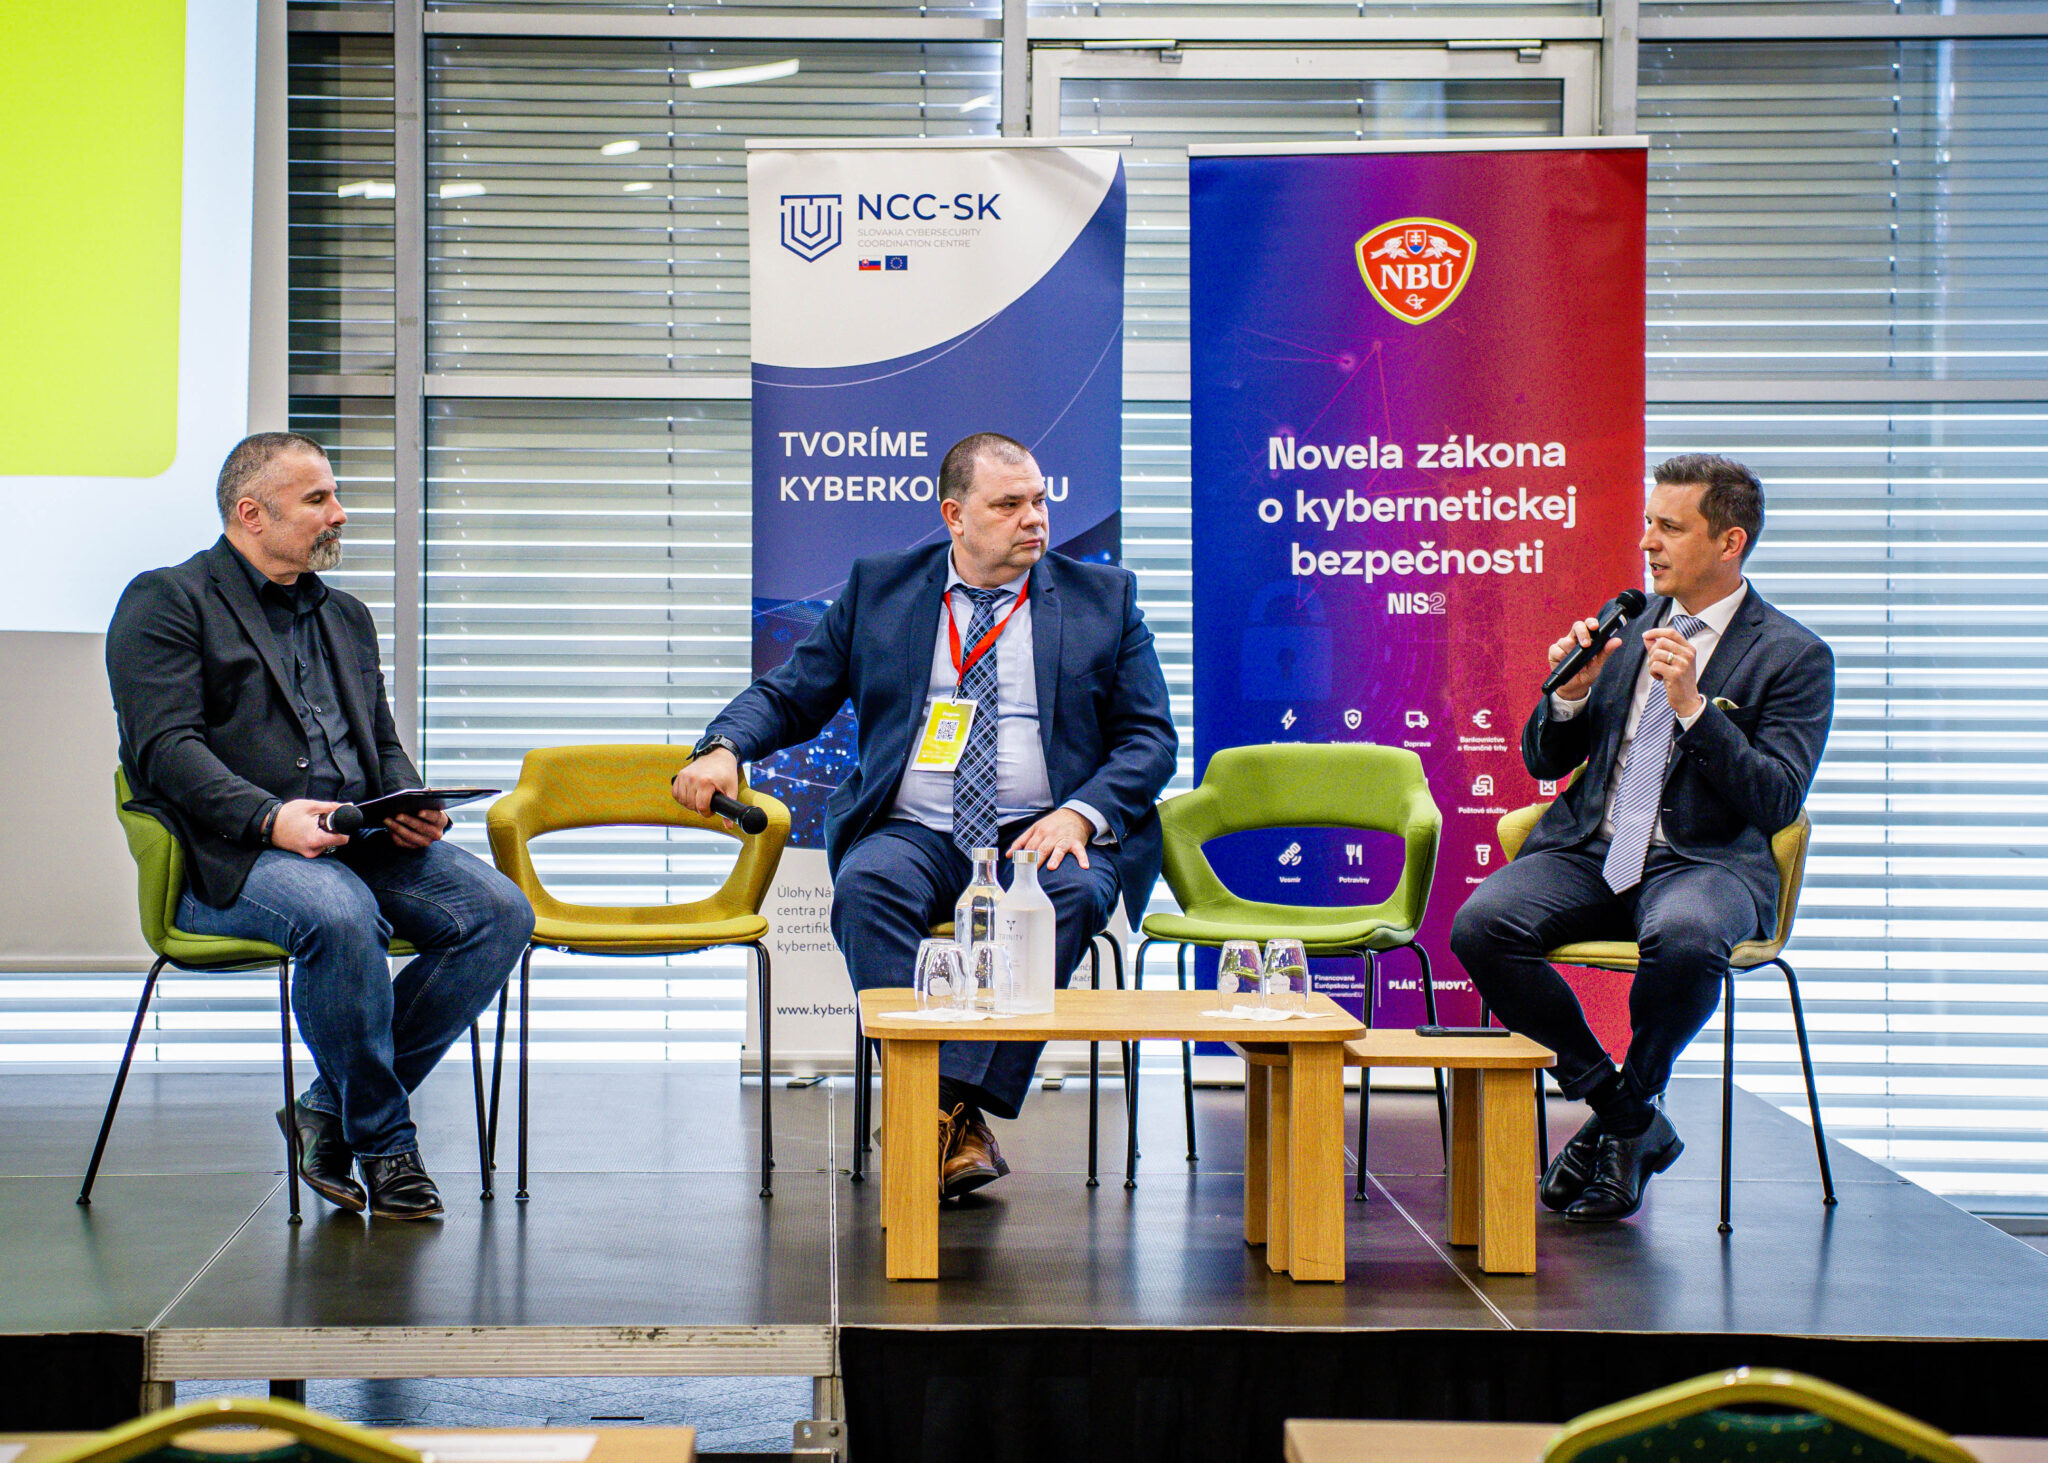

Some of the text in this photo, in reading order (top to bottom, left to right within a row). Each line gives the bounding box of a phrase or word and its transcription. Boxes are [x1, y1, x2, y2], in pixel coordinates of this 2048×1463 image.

[858, 193, 1002, 221] NCC-SK
[857, 228, 982, 237] SLOVAKIA CYBERSECURITY
[857, 239, 971, 248] COORDINATION CENTRE
[1380, 259, 1454, 290] NBÚ
[778, 427, 929, 458] TVORÍME
[1269, 435, 1566, 470] Novela zákona
[1258, 485, 1577, 531] o kybernetickej
[1291, 539, 1544, 583] bezpečnosti
[1387, 592, 1446, 615] NIS2
[1404, 740, 1431, 749] Doprava
[1338, 876, 1370, 885] Potraviny
[777, 884, 812, 900] Úlohy
[777, 904, 816, 916] centra
[777, 921, 830, 934] a certifik
[1350, 982, 1366, 990] únio
[1388, 979, 1468, 991] PLÁN BNOVY
[776, 1004, 856, 1018] www.kyberk
